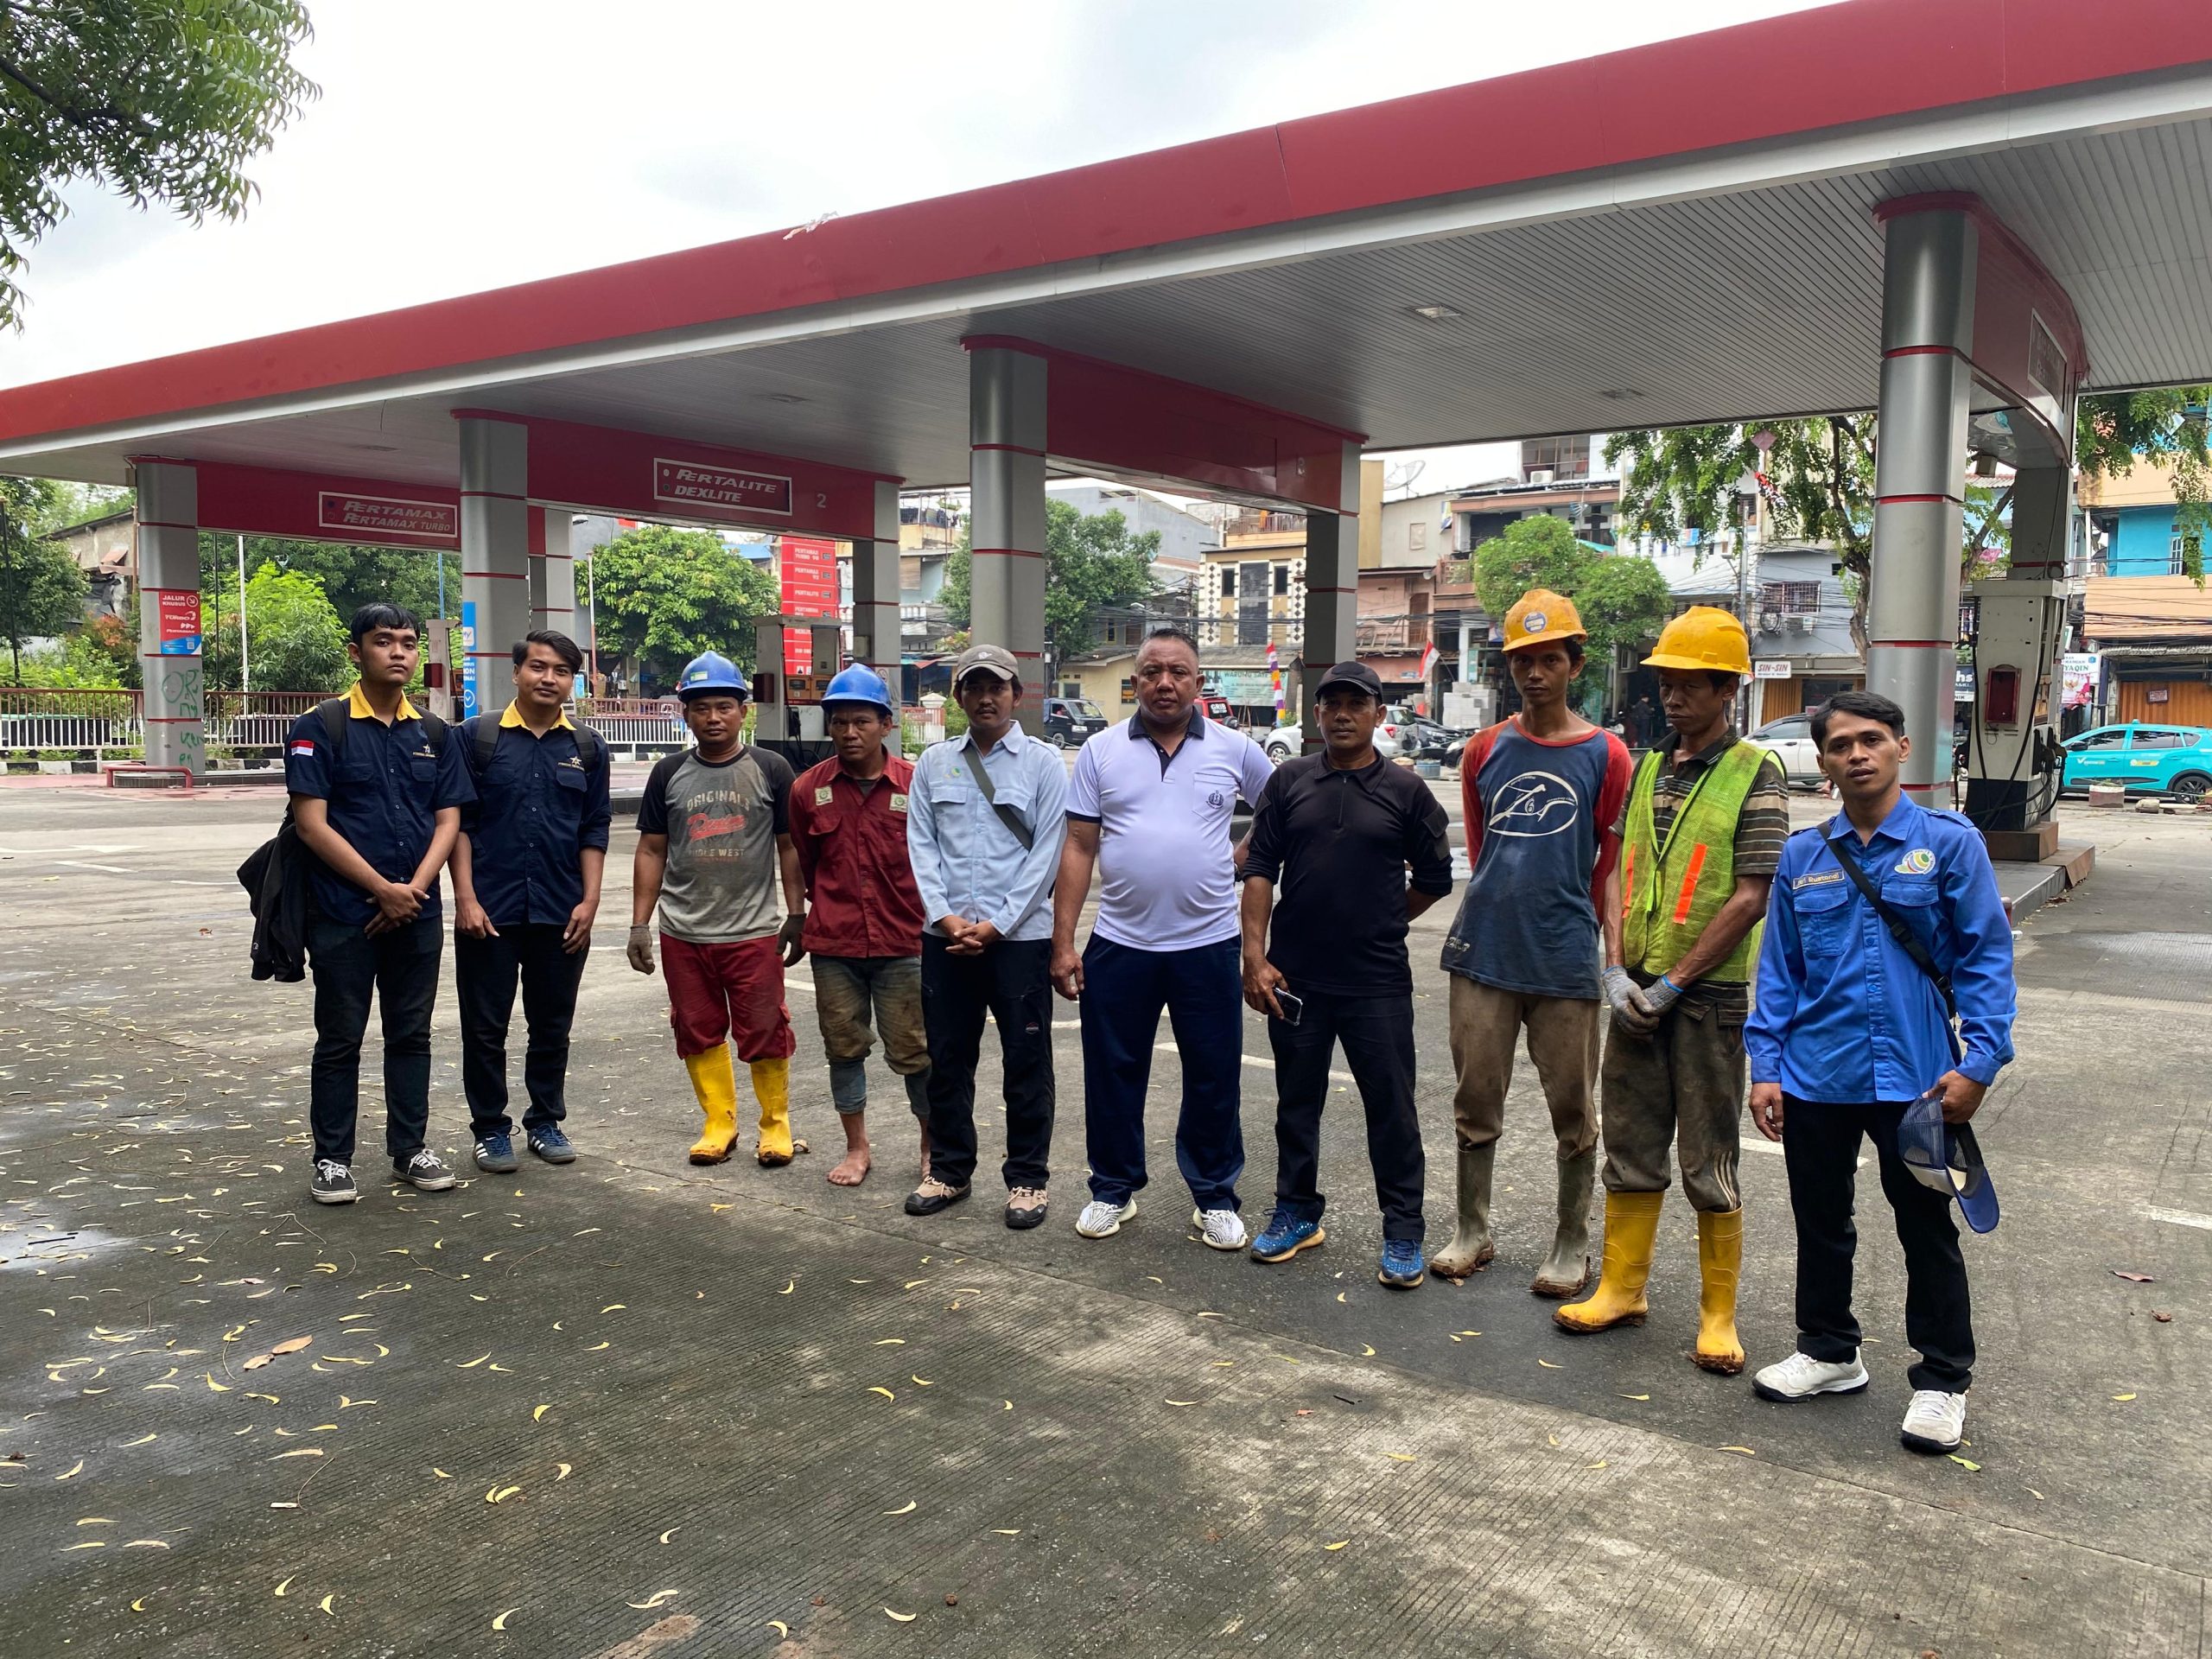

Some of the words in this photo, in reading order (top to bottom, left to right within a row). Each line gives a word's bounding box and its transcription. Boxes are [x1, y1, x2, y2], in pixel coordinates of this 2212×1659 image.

[676, 468, 778, 493] PERTALITE
[675, 485, 742, 503] DEXLITE
[817, 493, 827, 508] 2
[343, 500, 448, 520] PERTAMAX
[343, 512, 416, 529] PERTAMAX
[421, 521, 450, 531] TURBO
[1758, 664, 1789, 672] SIN-SIN
[687, 790, 750, 812] ORIGINALS
[718, 849, 746, 857] WEST
